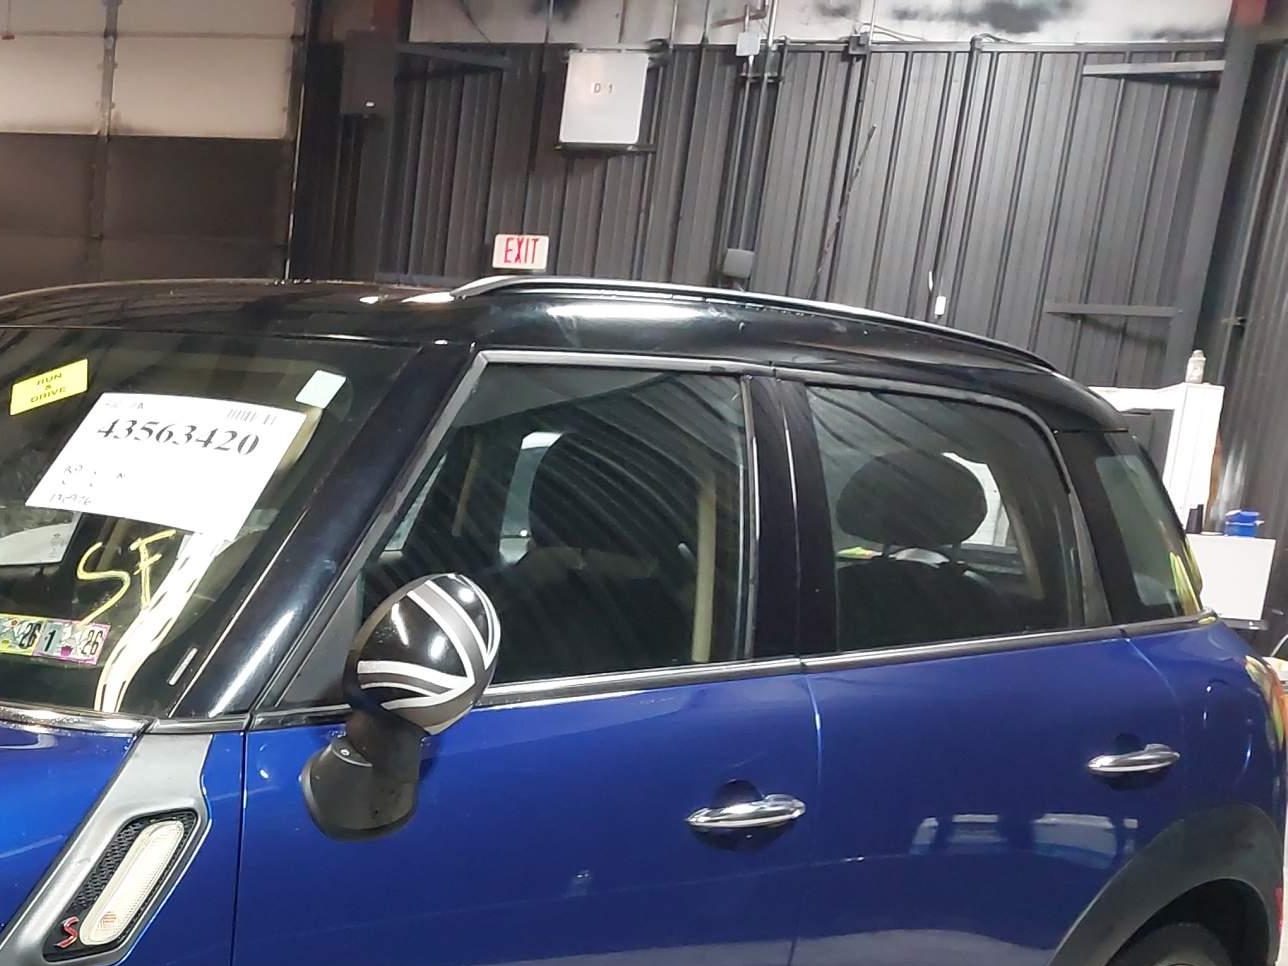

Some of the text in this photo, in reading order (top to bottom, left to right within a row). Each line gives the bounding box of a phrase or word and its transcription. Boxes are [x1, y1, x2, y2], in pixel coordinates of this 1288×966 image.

[504, 237, 540, 264] EXIT
[30, 386, 67, 403] DRIVE
[97, 417, 261, 455] 43563420
[76, 528, 177, 628] SF
[56, 915, 80, 949] S
